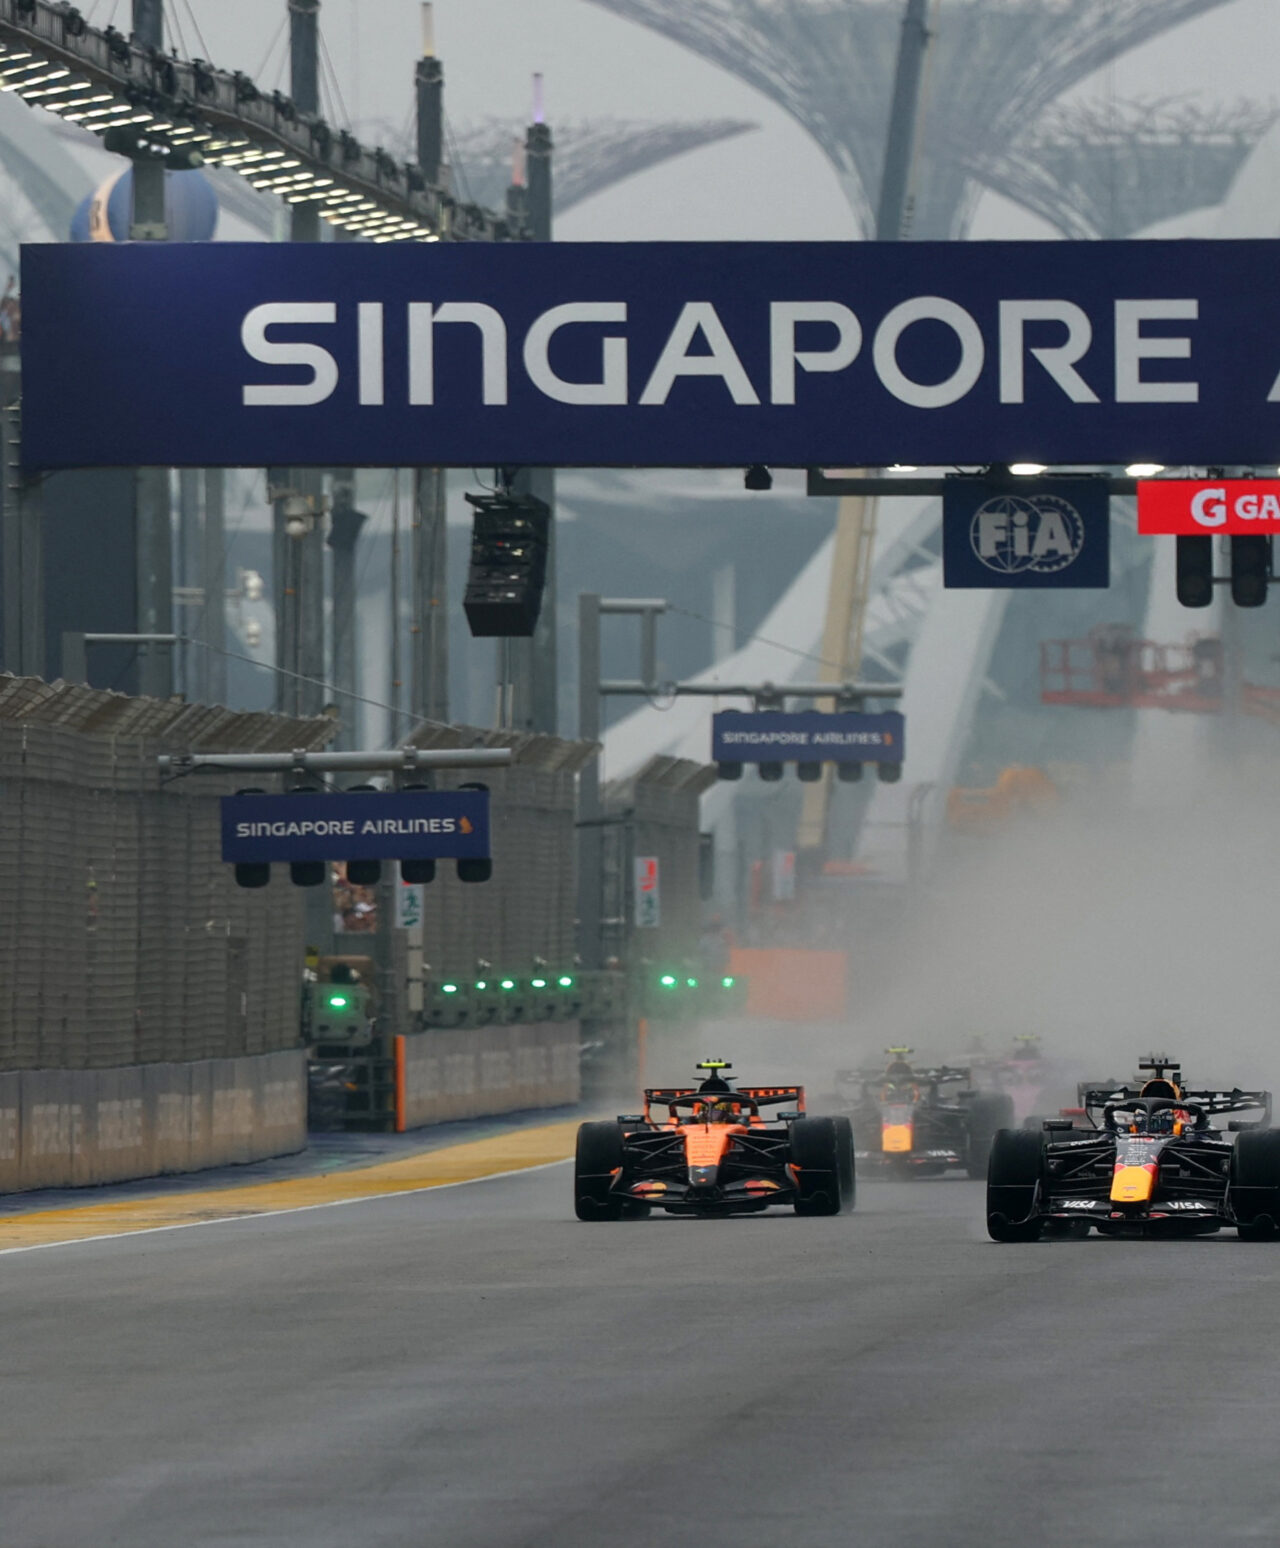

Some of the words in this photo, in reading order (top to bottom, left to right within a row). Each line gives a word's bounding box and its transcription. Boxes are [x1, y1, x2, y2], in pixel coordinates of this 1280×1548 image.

[240, 296, 1199, 407] SINGAPORE
[722, 732, 809, 744] SINGAPORE
[813, 732, 882, 744] AIRLINES
[236, 820, 355, 837] SINGAPORE
[361, 818, 456, 835] AIRLINES
[1062, 1201, 1097, 1209] VISA
